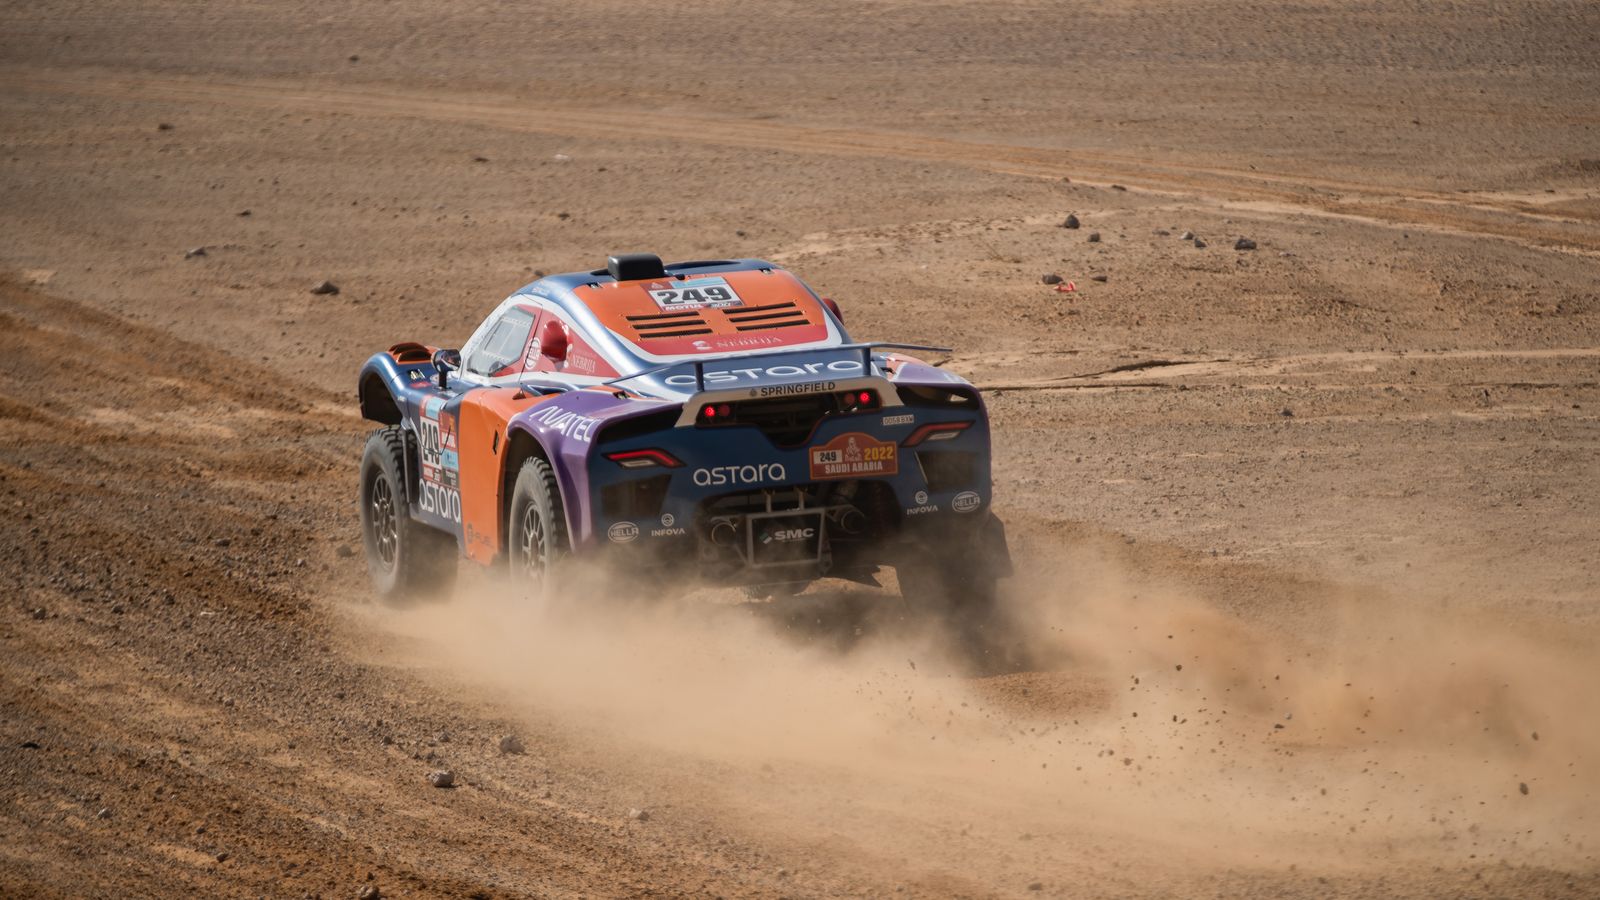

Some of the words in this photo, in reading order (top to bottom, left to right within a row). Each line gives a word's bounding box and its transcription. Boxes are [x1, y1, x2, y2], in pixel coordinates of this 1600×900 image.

[657, 286, 732, 305] 249
[664, 360, 864, 386] astara
[760, 381, 835, 397] SPRINGFIELD
[422, 421, 440, 465] 249
[820, 451, 837, 462] 249
[864, 446, 894, 460] 2022
[825, 464, 850, 474] SAUDI
[852, 460, 883, 473] ARABIA
[693, 463, 786, 487] astara
[419, 479, 461, 523] astara
[953, 495, 981, 508] HELLA
[907, 504, 938, 515] INFOVA
[610, 528, 639, 538] HELLA
[651, 527, 686, 537] INFOVA
[774, 527, 814, 540] SMC
